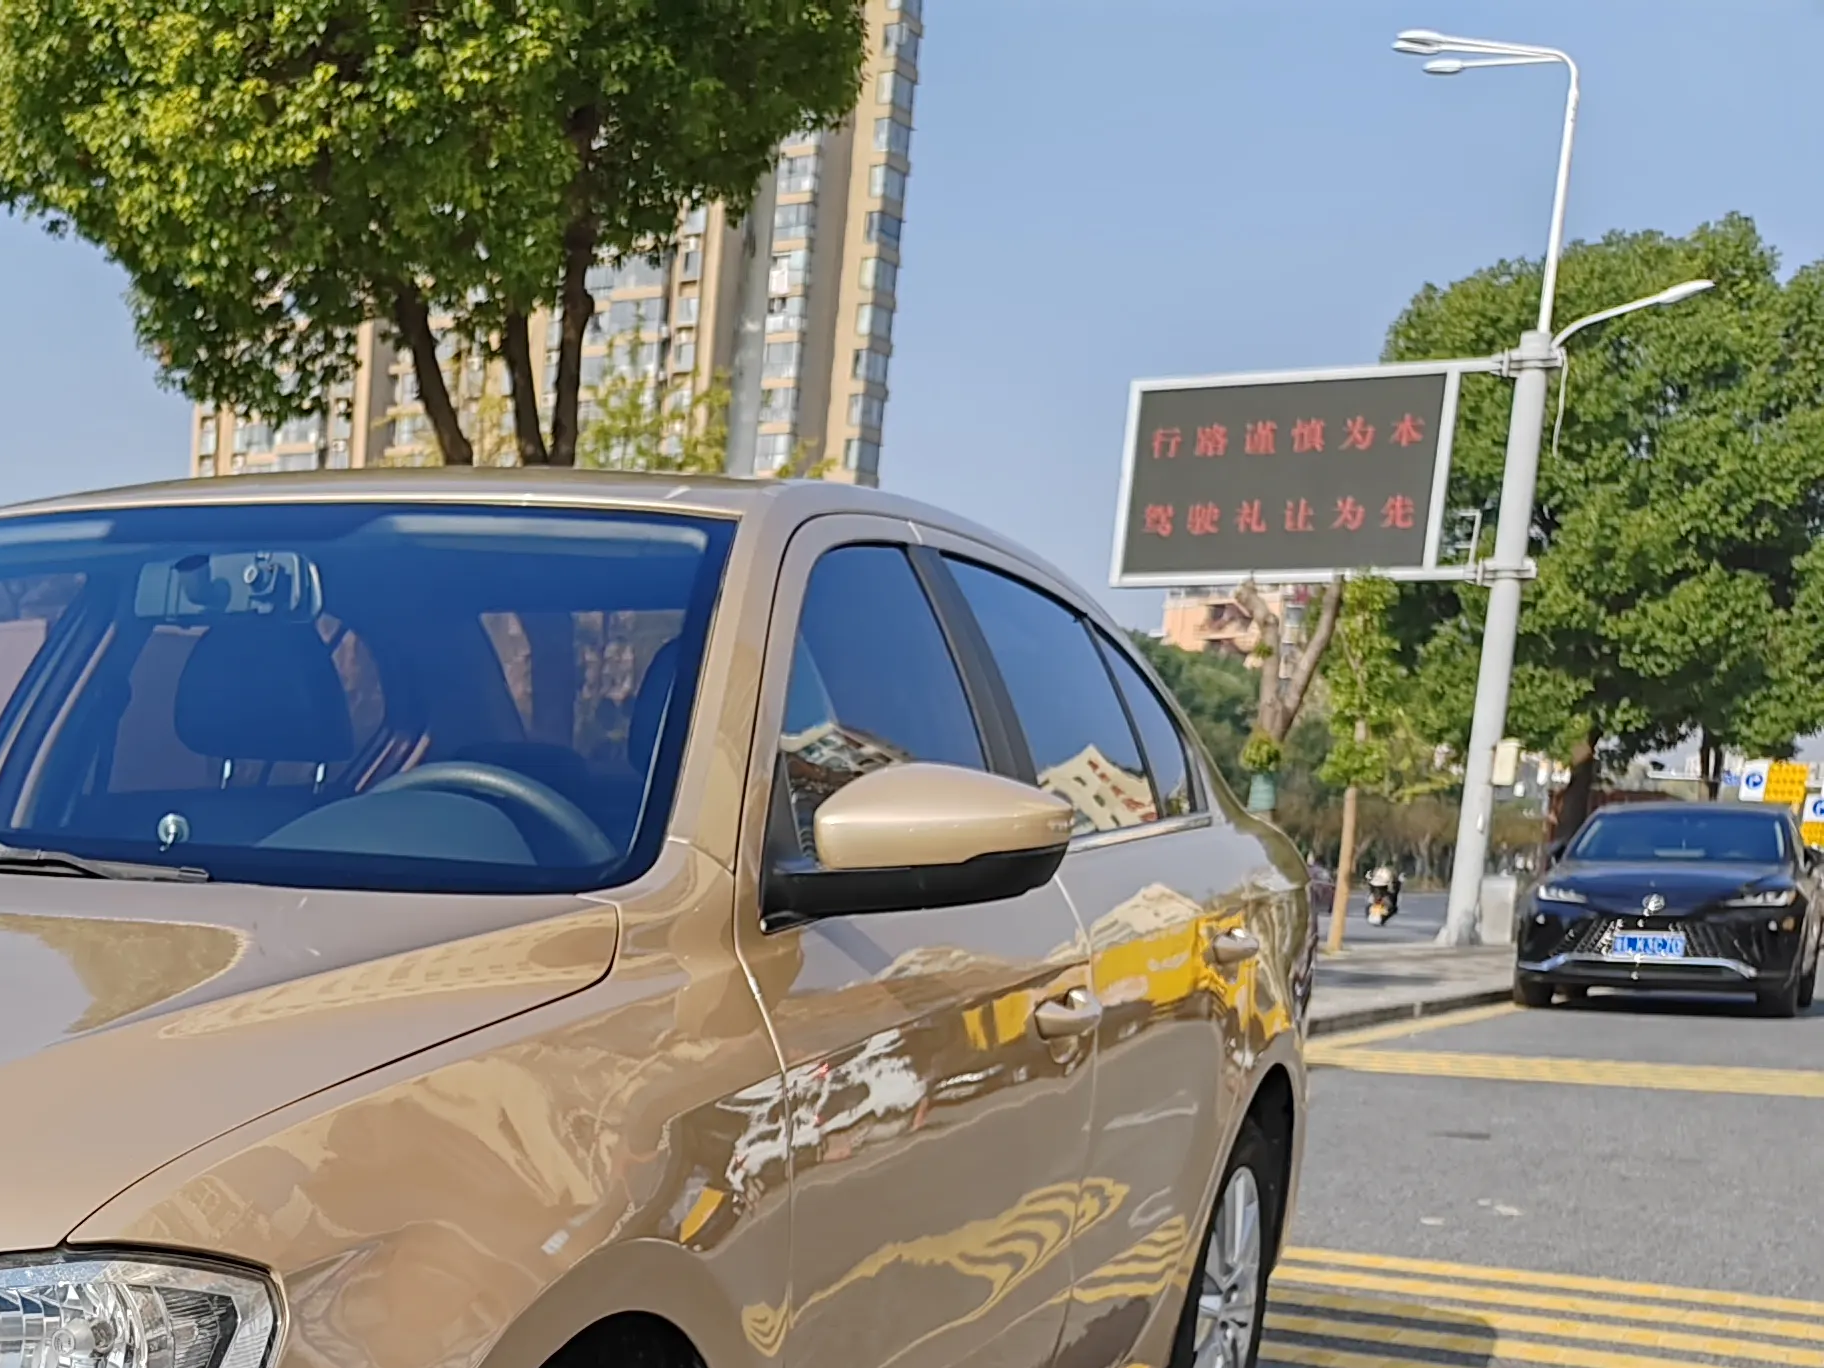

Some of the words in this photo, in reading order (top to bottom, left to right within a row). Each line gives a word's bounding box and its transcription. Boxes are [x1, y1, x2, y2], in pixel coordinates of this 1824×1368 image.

[1151, 412, 1425, 459] 行路谨慎为本
[1142, 494, 1416, 538] 驾驶礼让为先
